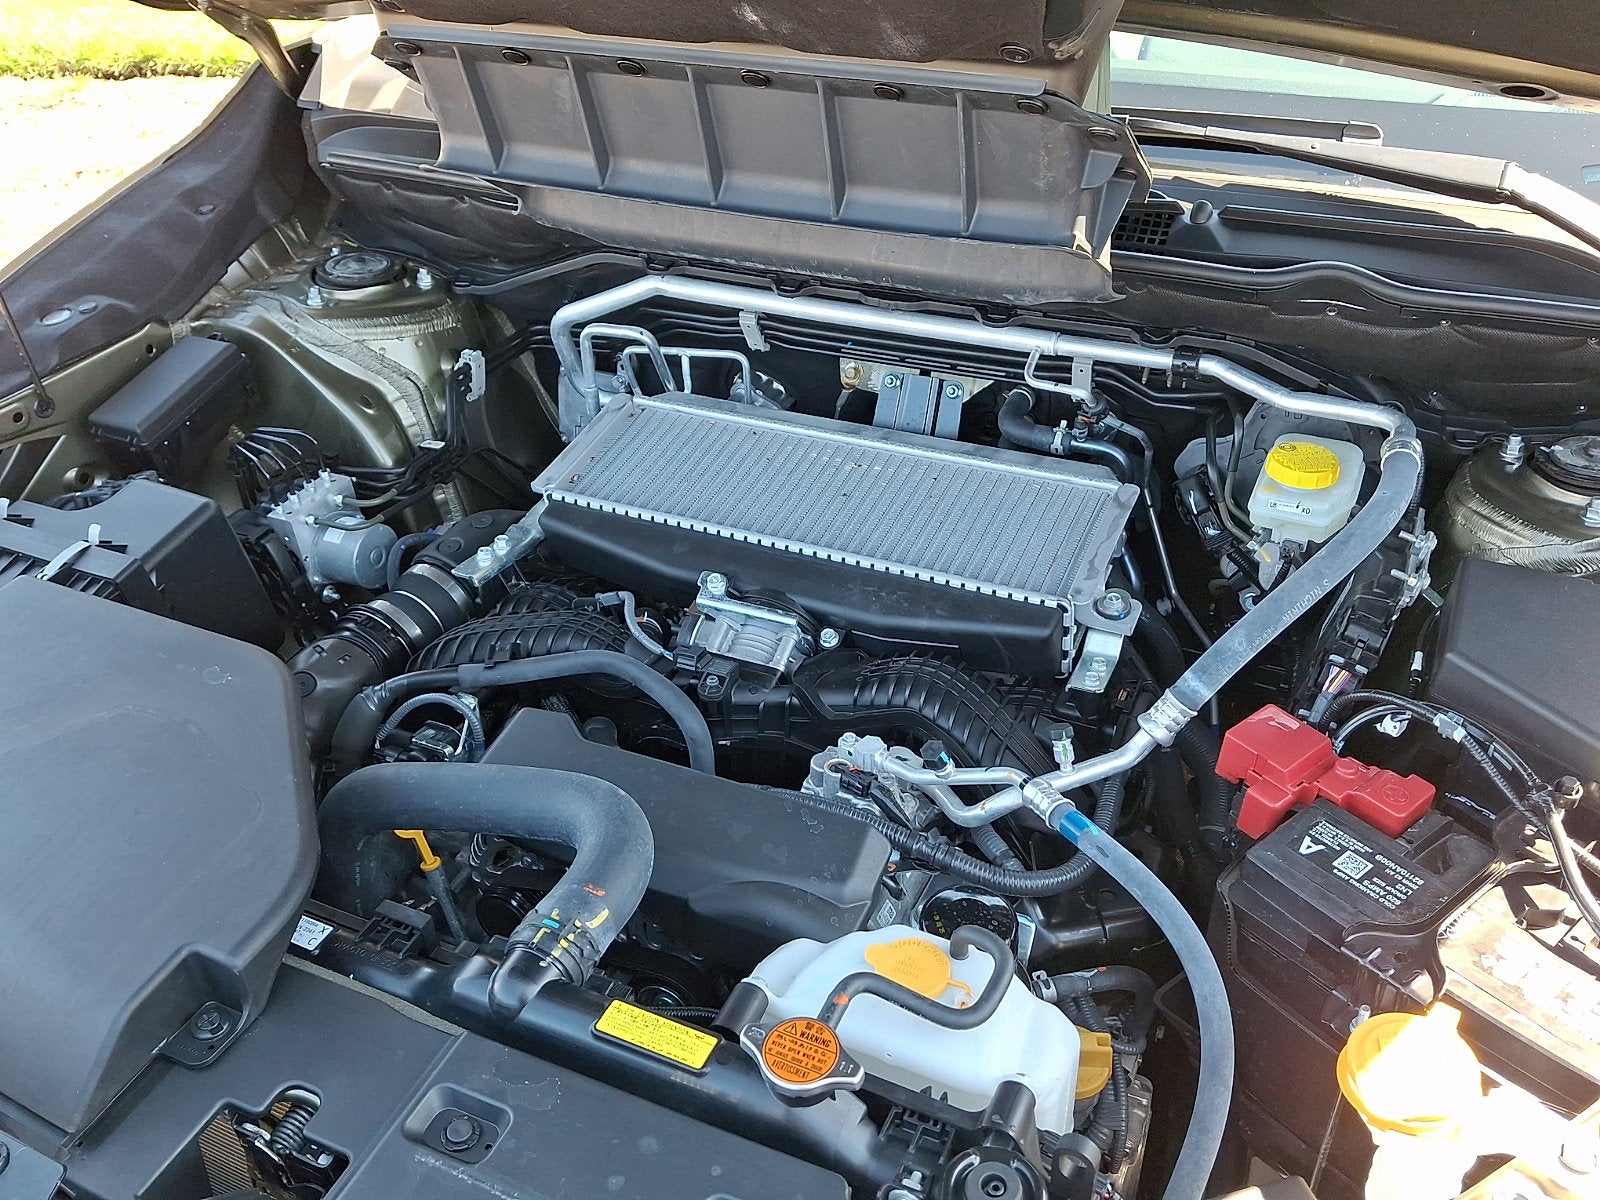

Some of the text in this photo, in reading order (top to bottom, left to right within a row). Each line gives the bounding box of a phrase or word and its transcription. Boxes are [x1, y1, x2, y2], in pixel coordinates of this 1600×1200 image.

[1298, 834, 1327, 856] A
[1332, 868, 1396, 909] COLD CRANKING AMPS
[1361, 879, 1387, 896] AMPS
[1371, 876, 1407, 899] GROUP SIZE
[1394, 882, 1413, 895] LN2
[798, 1029, 831, 1048] WARNING
[771, 1039, 786, 1049] NEVER
[787, 1046, 800, 1055] OPEN
[801, 1052, 815, 1061] WHEN
[838, 1060, 853, 1074] 1.1
